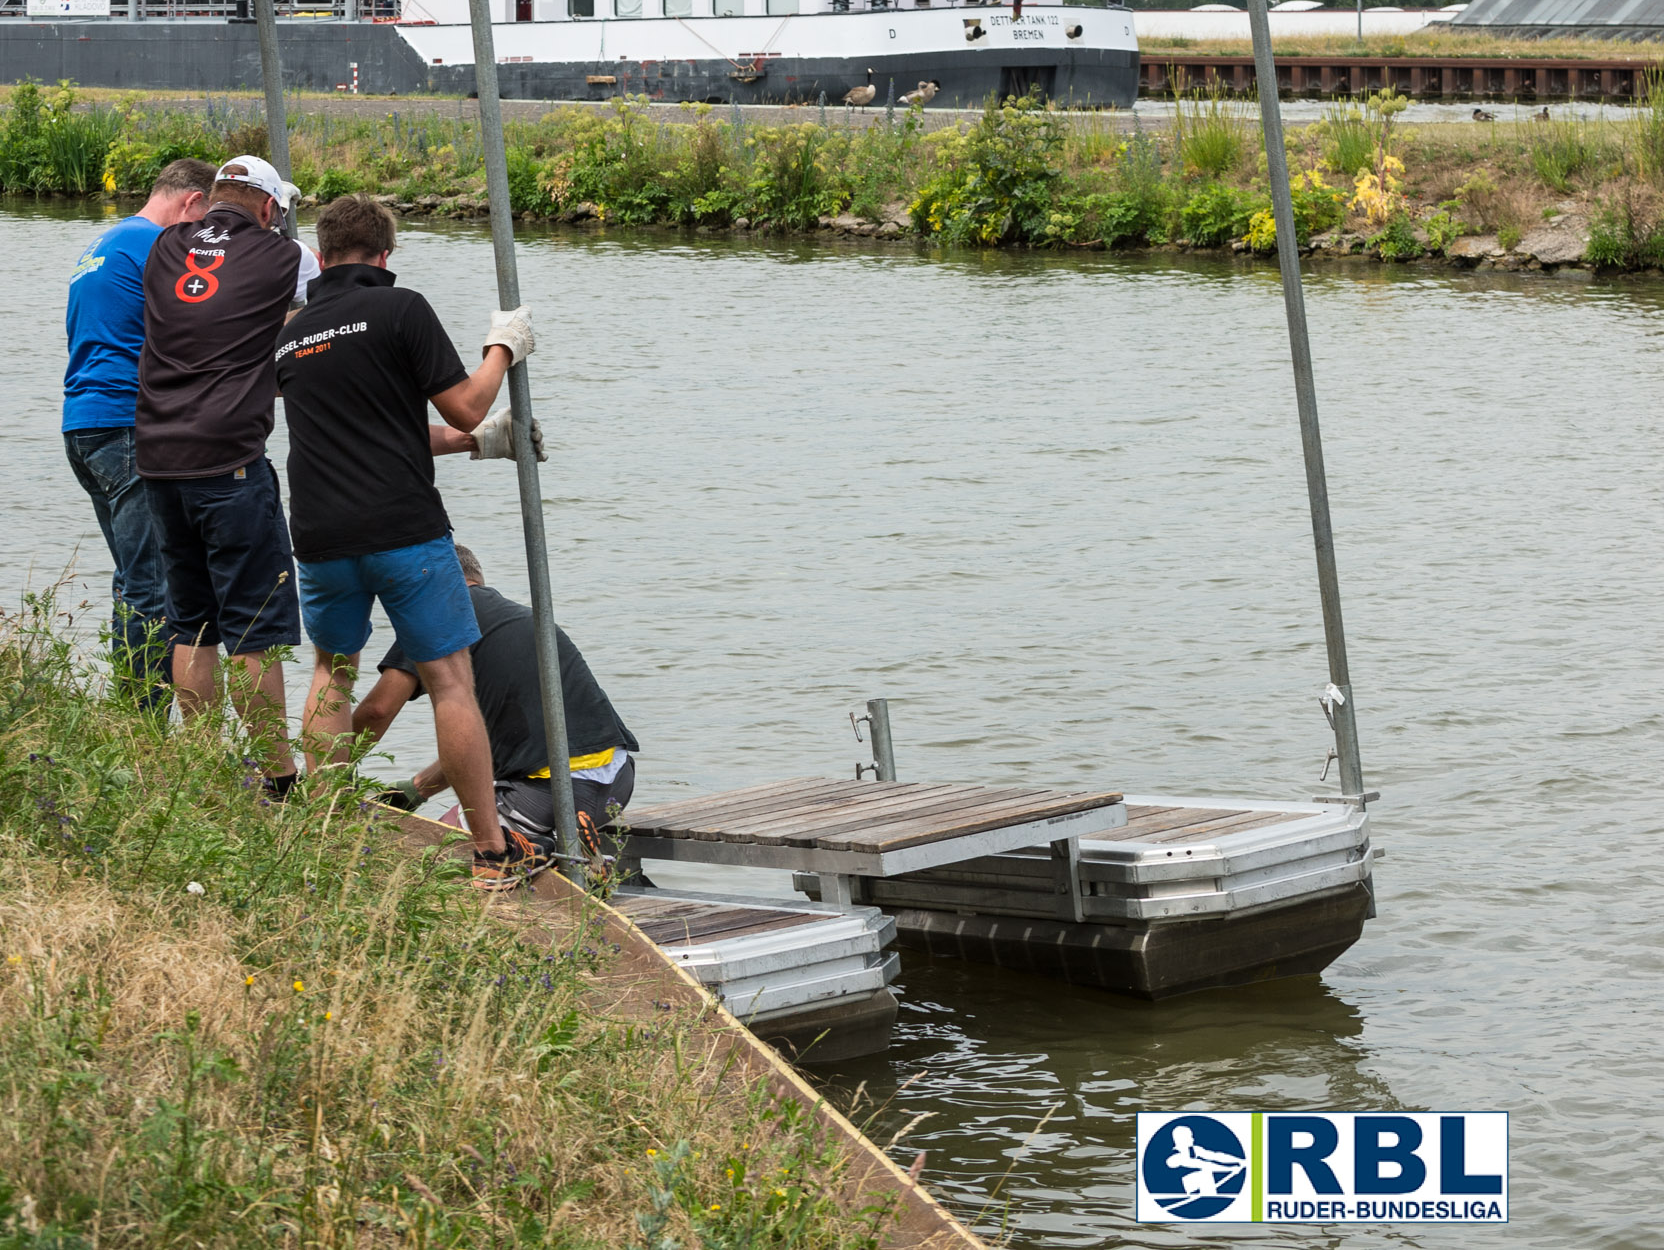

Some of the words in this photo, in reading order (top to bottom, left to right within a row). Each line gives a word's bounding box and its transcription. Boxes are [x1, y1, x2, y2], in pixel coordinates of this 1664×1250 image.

[1026, 15, 1046, 25] TANK
[1047, 15, 1059, 25] 122
[889, 29, 896, 39] D
[1013, 30, 1045, 40] BREMEN
[189, 247, 226, 257] ACHTER
[294, 346, 314, 358] TEAM
[315, 342, 331, 354] 2011
